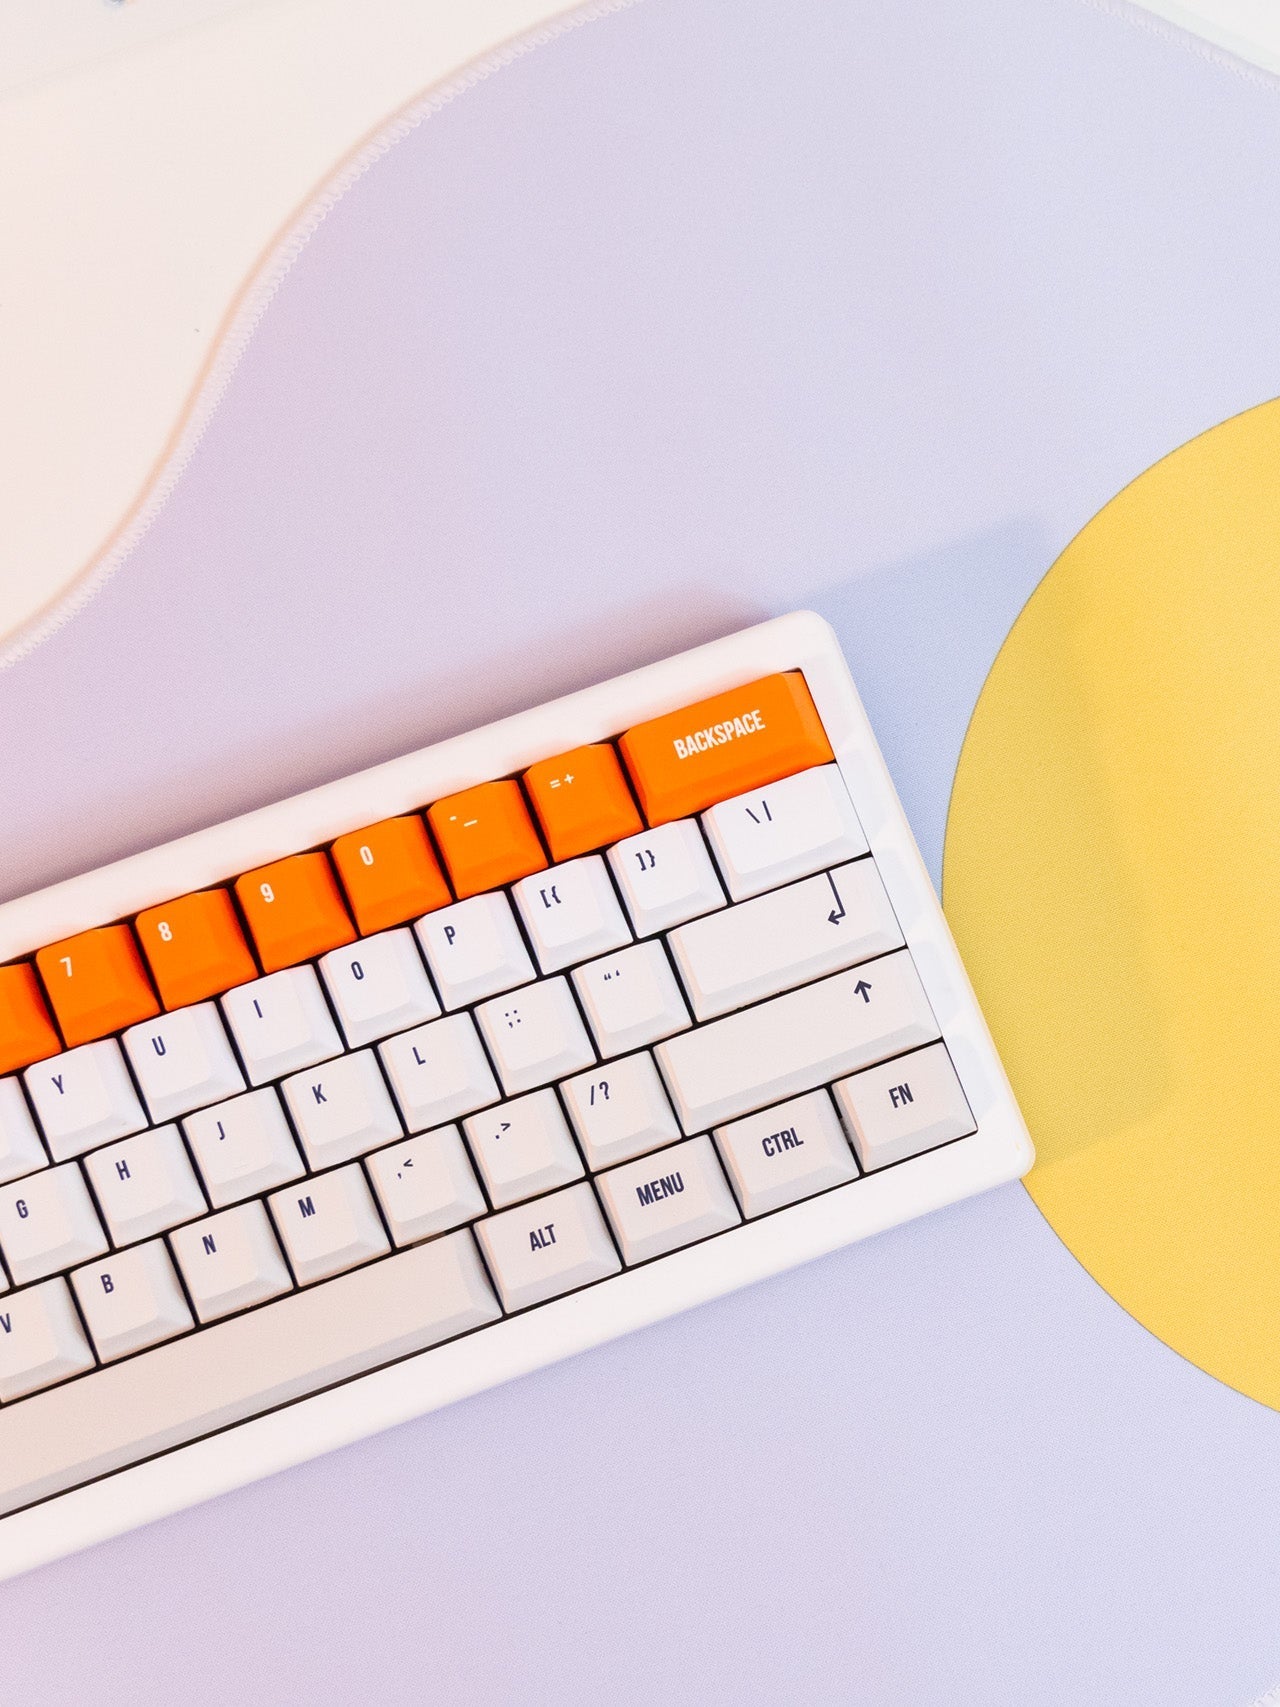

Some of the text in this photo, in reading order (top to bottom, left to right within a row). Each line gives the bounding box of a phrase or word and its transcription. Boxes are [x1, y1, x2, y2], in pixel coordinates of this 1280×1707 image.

[672, 709, 766, 760] BACKSPACE
[260, 883, 275, 903] 9
[157, 921, 173, 942] 8
[443, 925, 456, 946] P
[60, 956, 73, 977] 7
[350, 961, 365, 981] O
[252, 999, 263, 1019] I
[151, 1035, 166, 1057] U
[412, 1046, 426, 1066] L
[51, 1074, 65, 1095] Y
[311, 1083, 328, 1105] K
[888, 1082, 914, 1109] FN
[216, 1121, 226, 1141] J
[761, 1127, 805, 1157] CTRL
[115, 1159, 131, 1181] H
[635, 1171, 685, 1207] MENU
[15, 1199, 29, 1219] G
[297, 1196, 316, 1218] M
[201, 1234, 217, 1256] N
[529, 1223, 557, 1252] ALT
[100, 1273, 115, 1294] B
[0, 1312, 12, 1334] V
